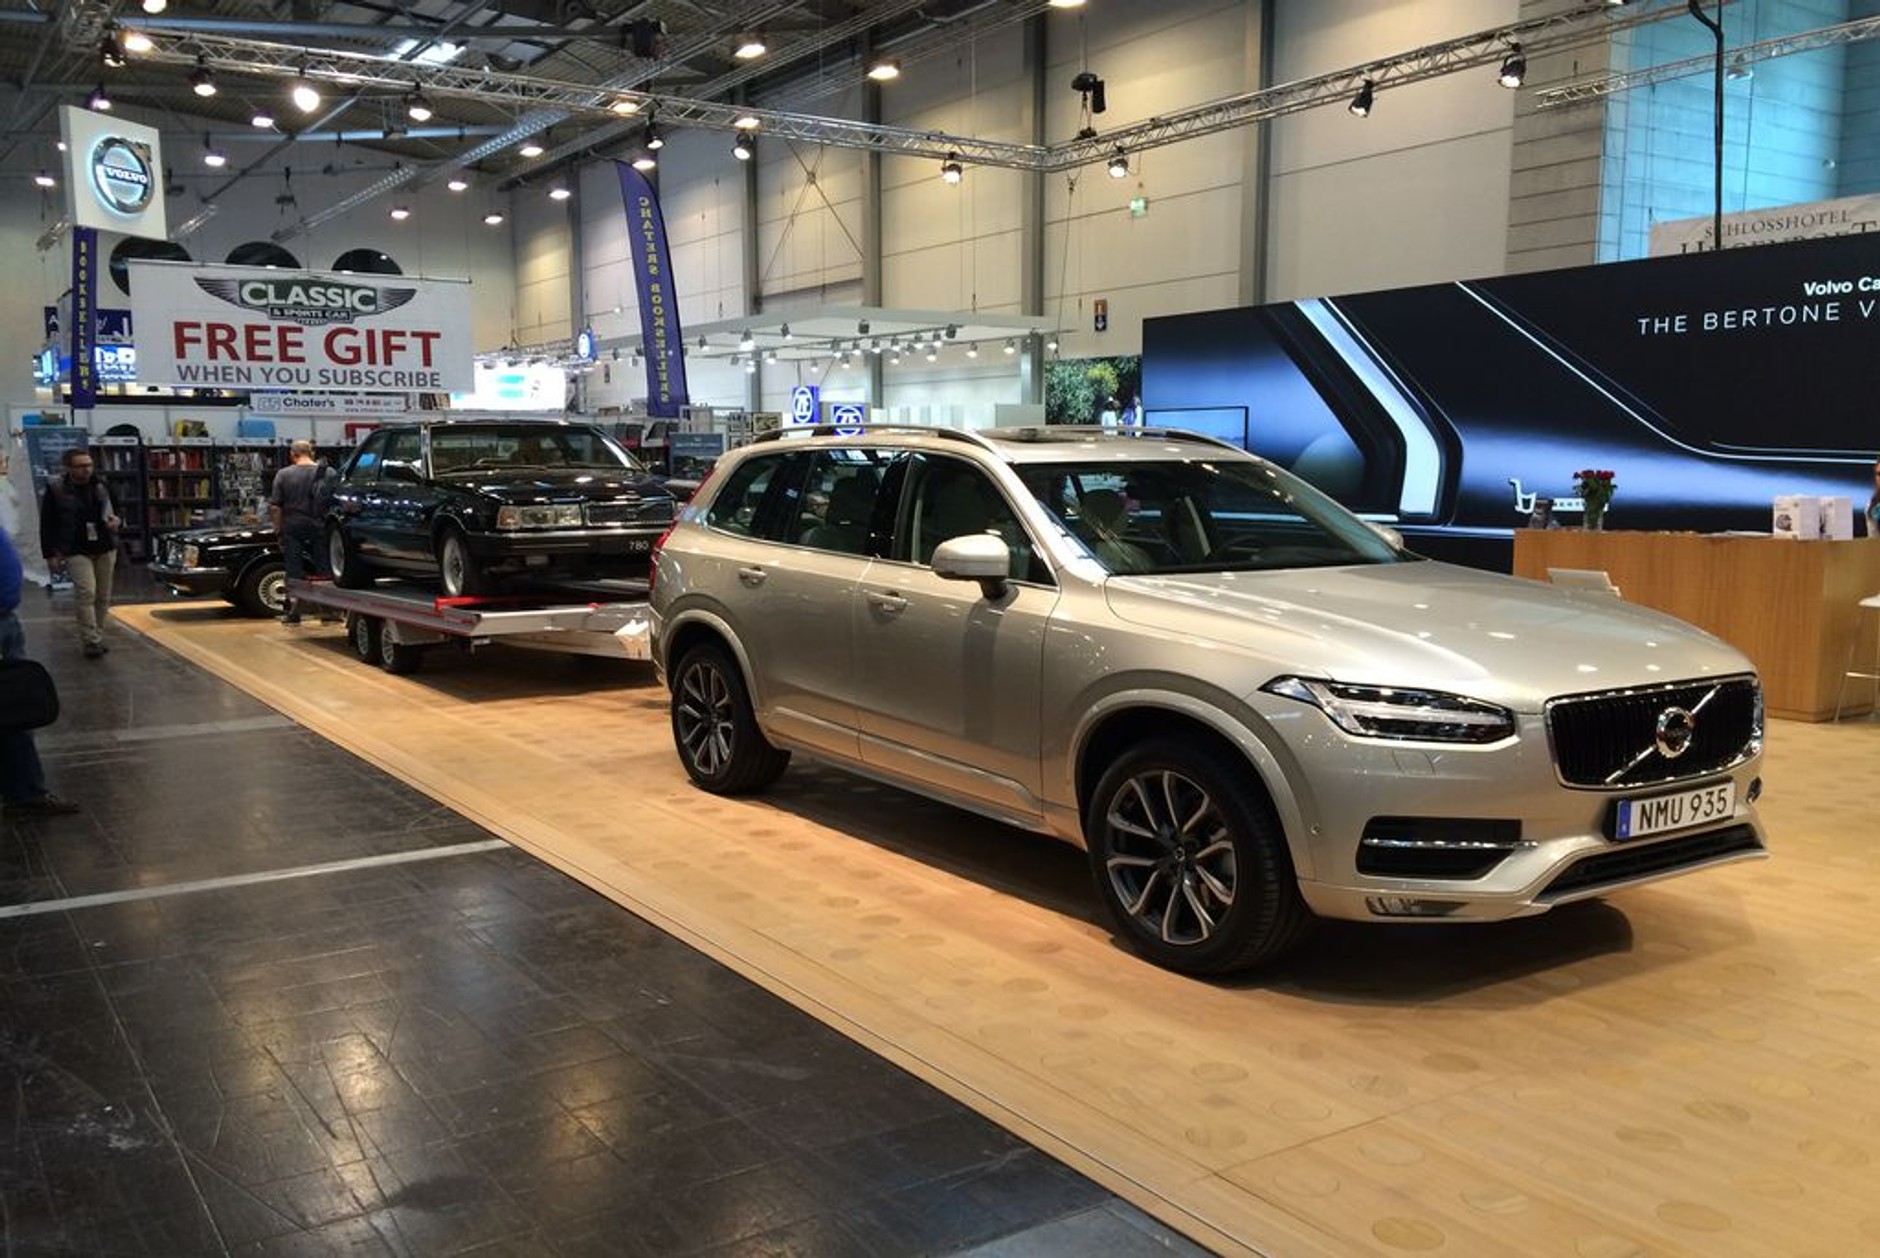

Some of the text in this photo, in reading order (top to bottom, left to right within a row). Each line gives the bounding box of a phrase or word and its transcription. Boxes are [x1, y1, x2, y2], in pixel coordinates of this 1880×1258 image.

[105, 167, 148, 183] VOLVO
[1705, 209, 1851, 238] SHLOSSHOTEL
[240, 281, 376, 312] CLASSIC
[1803, 280, 1853, 296] Volvo
[283, 309, 323, 318] SPORTS
[326, 311, 348, 319] CAR
[1638, 315, 1687, 335] THE
[1703, 301, 1841, 330] BERTONE
[173, 321, 306, 363] FREE
[324, 327, 441, 367] GIFT
[177, 364, 441, 388] WHEN YOU SUBSCRIBE
[629, 540, 649, 550] 780
[1640, 788, 1727, 831] NMU 935
